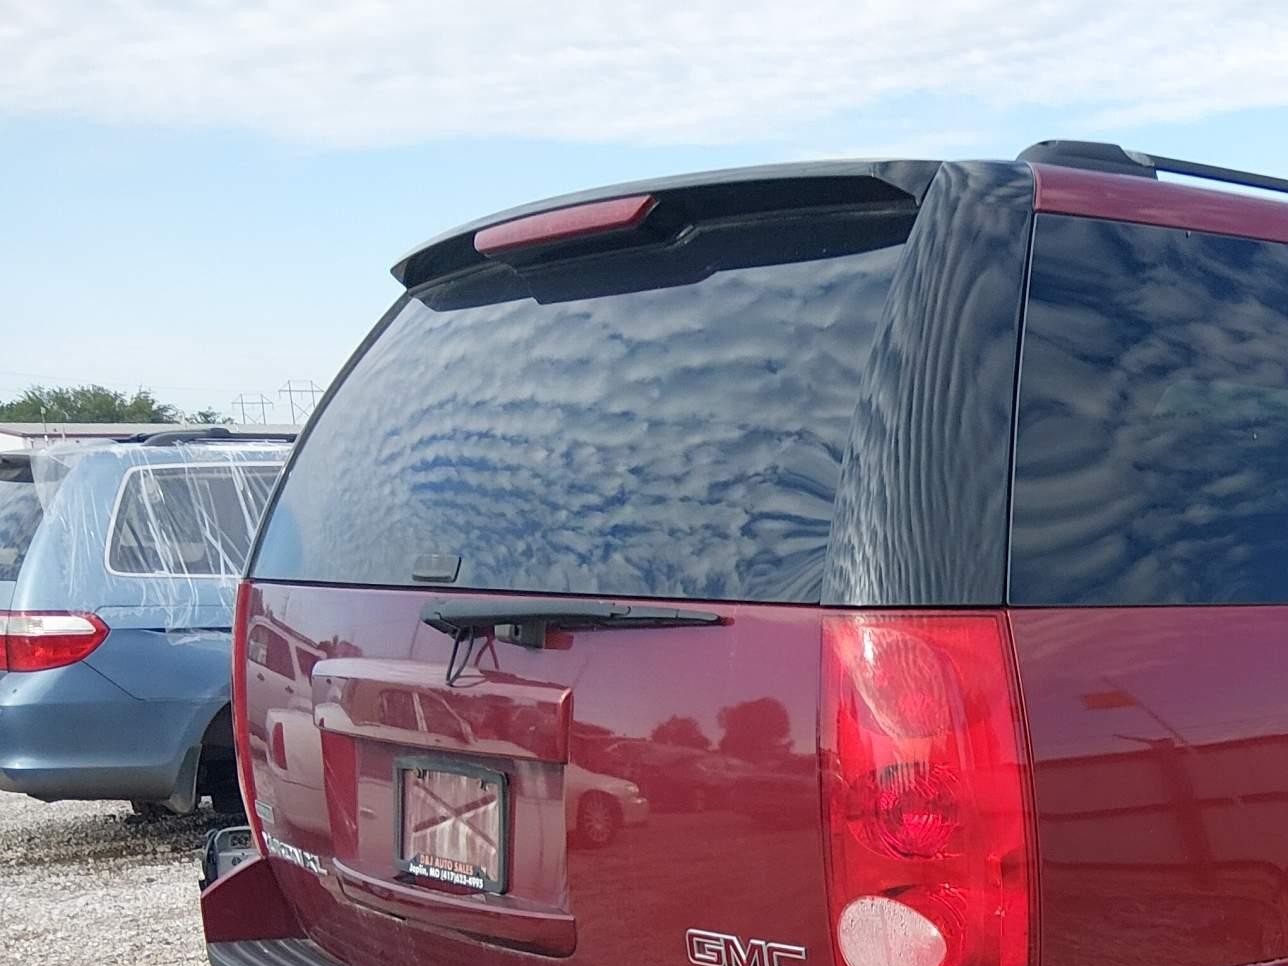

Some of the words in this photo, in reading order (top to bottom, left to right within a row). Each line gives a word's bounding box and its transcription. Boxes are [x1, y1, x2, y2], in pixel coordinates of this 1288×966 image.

[429, 867, 440, 878] MO
[435, 857, 453, 870] AUTO
[454, 862, 474, 876] SALES
